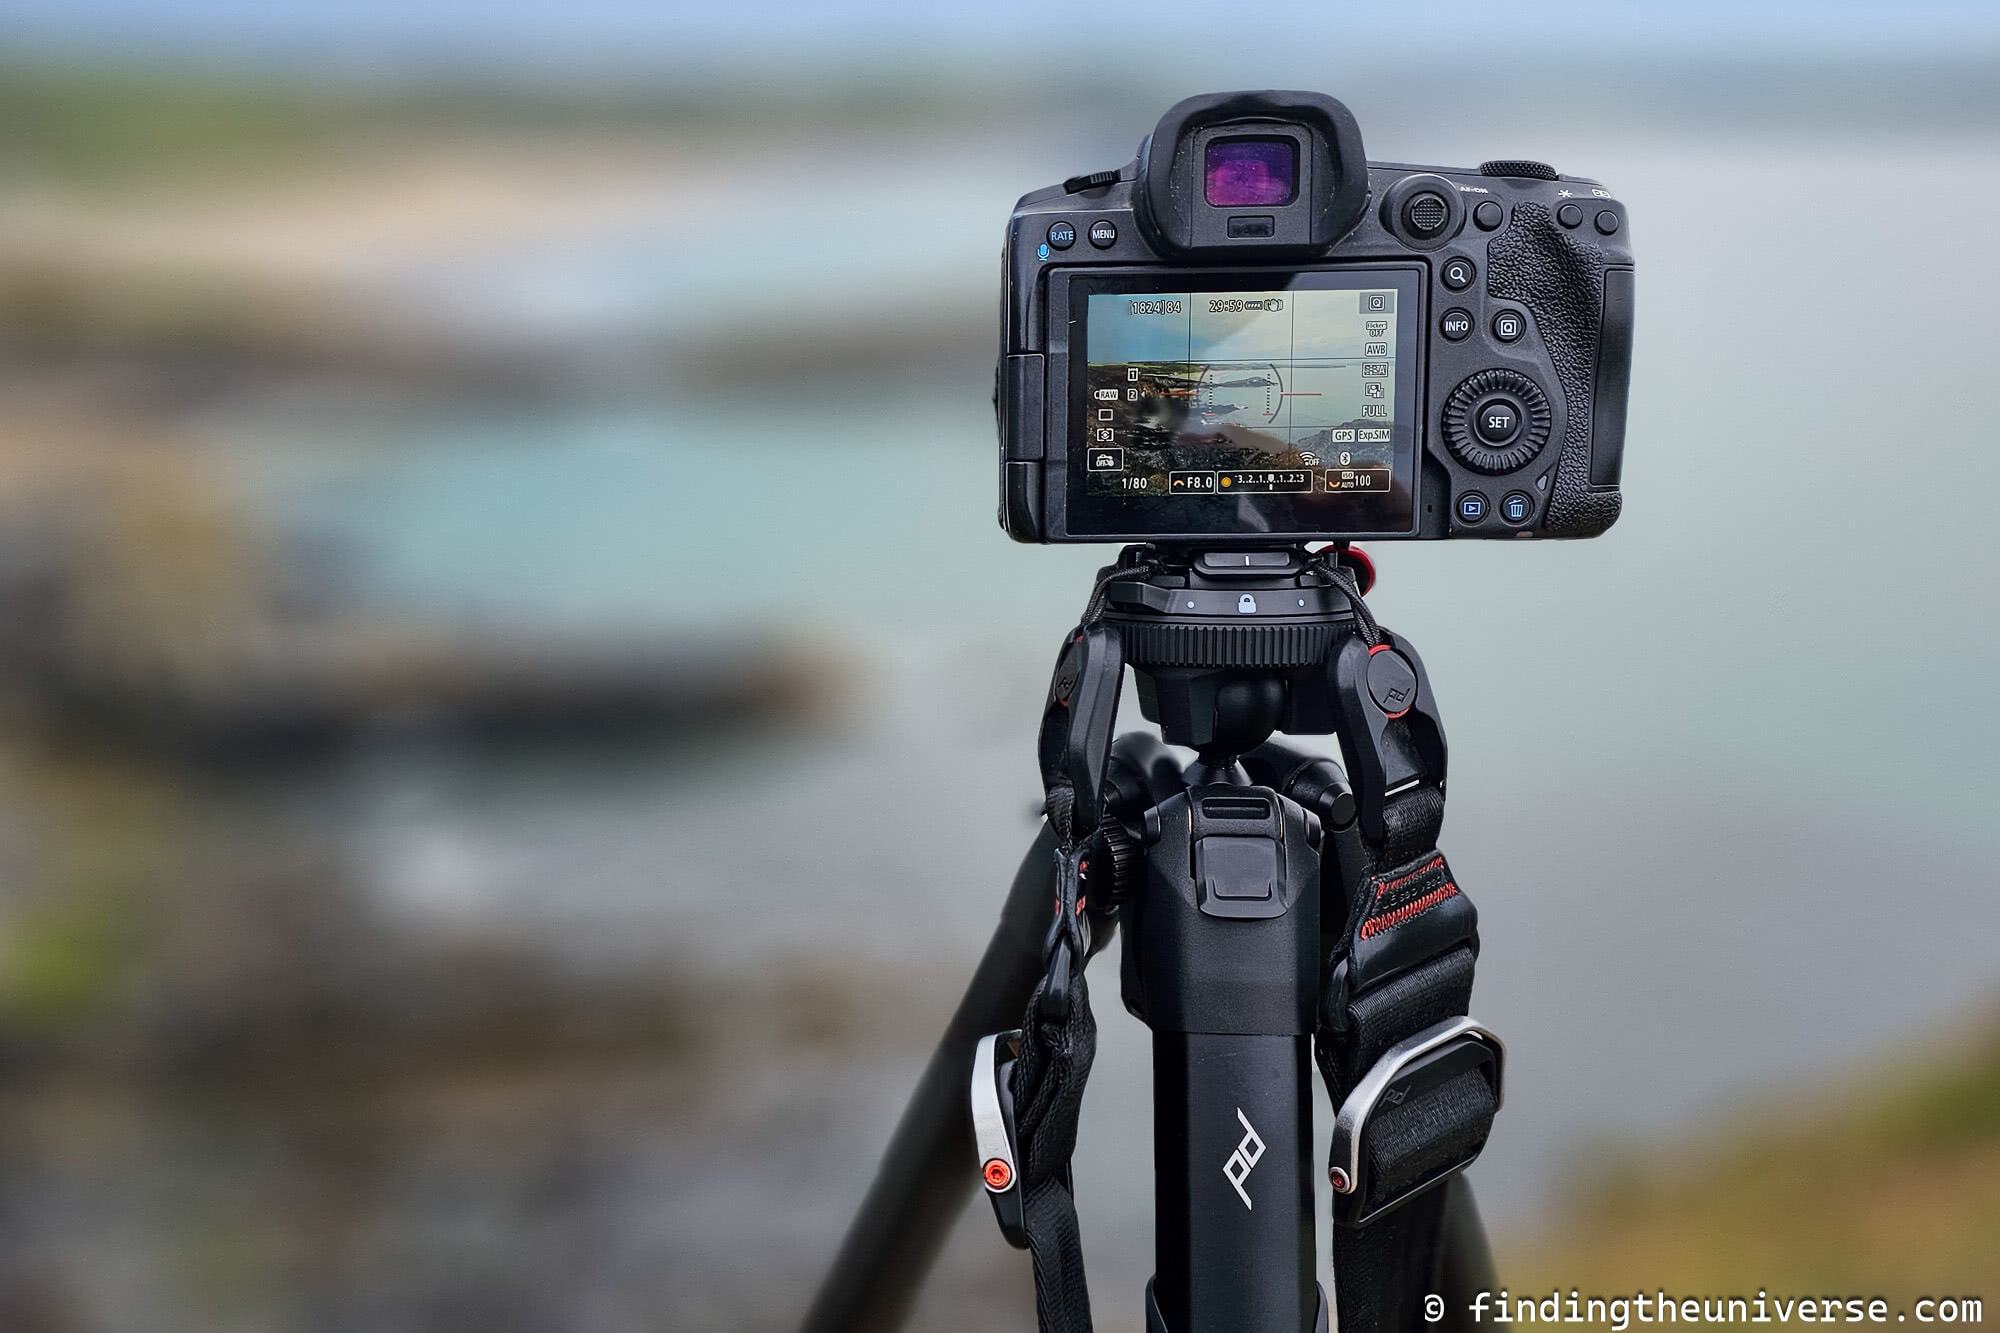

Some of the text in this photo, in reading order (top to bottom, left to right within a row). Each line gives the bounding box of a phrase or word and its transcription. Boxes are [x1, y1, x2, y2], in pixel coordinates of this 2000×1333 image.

[1051, 230, 1074, 240] RATE
[1092, 229, 1115, 239] MENU
[1209, 300, 1243, 313] 29:59
[1445, 320, 1468, 331] INFO
[1366, 344, 1386, 354] AWB
[1362, 405, 1387, 417] FULL
[1488, 416, 1509, 428] SET
[1335, 431, 1353, 440] GPS
[1358, 430, 1390, 441] Exp.SIM
[1121, 477, 1148, 489] 1/80
[1187, 476, 1213, 489] F8.0
[1354, 474, 1371, 487] 100
